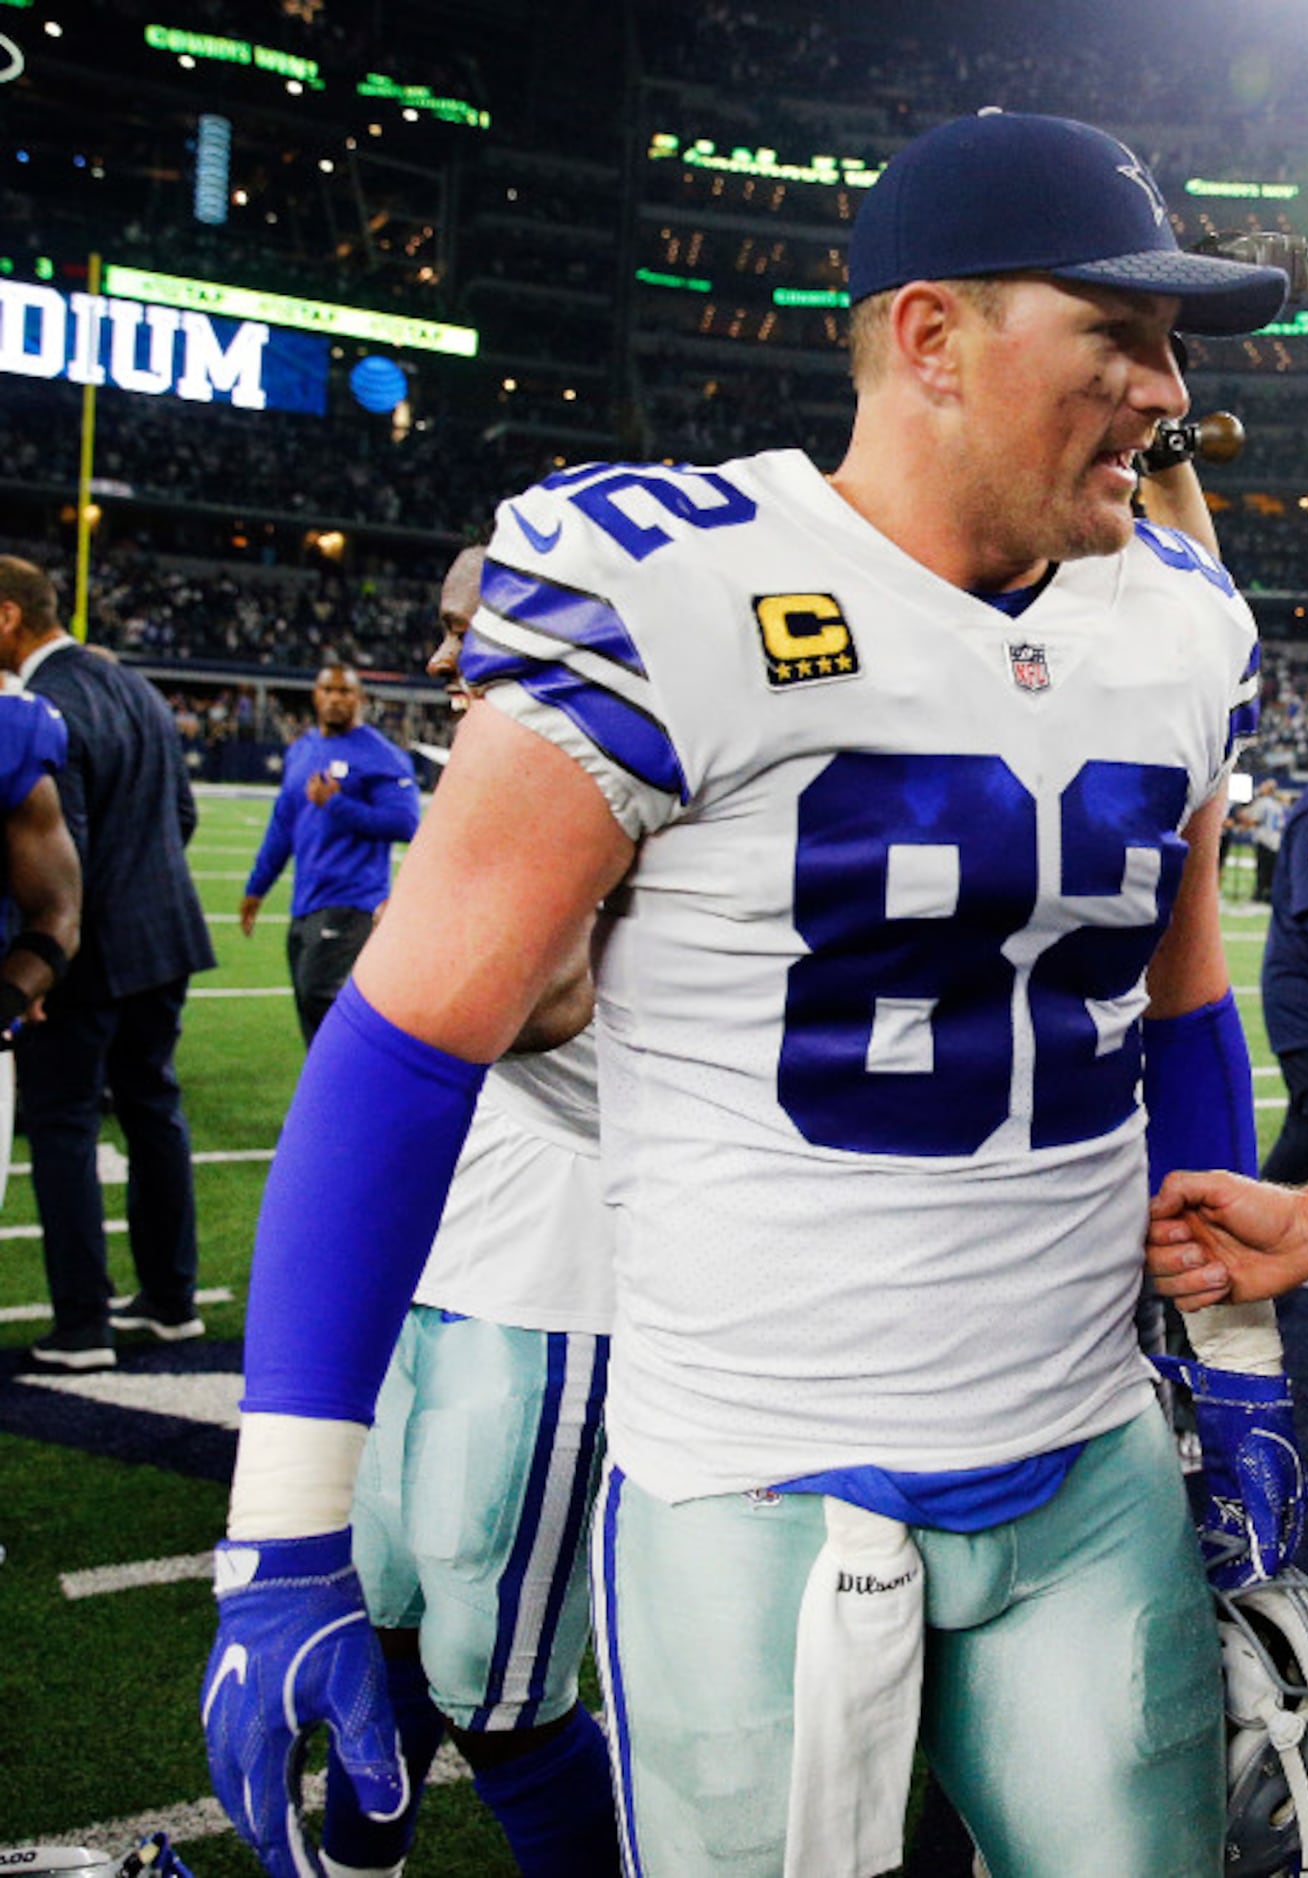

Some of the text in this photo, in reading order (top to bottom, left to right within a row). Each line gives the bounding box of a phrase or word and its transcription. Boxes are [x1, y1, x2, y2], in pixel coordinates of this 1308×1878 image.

[0, 279, 270, 411] DIUM
[757, 592, 849, 661] C
[1014, 662, 1047, 687] NFL
[777, 751, 1190, 1157] 82
